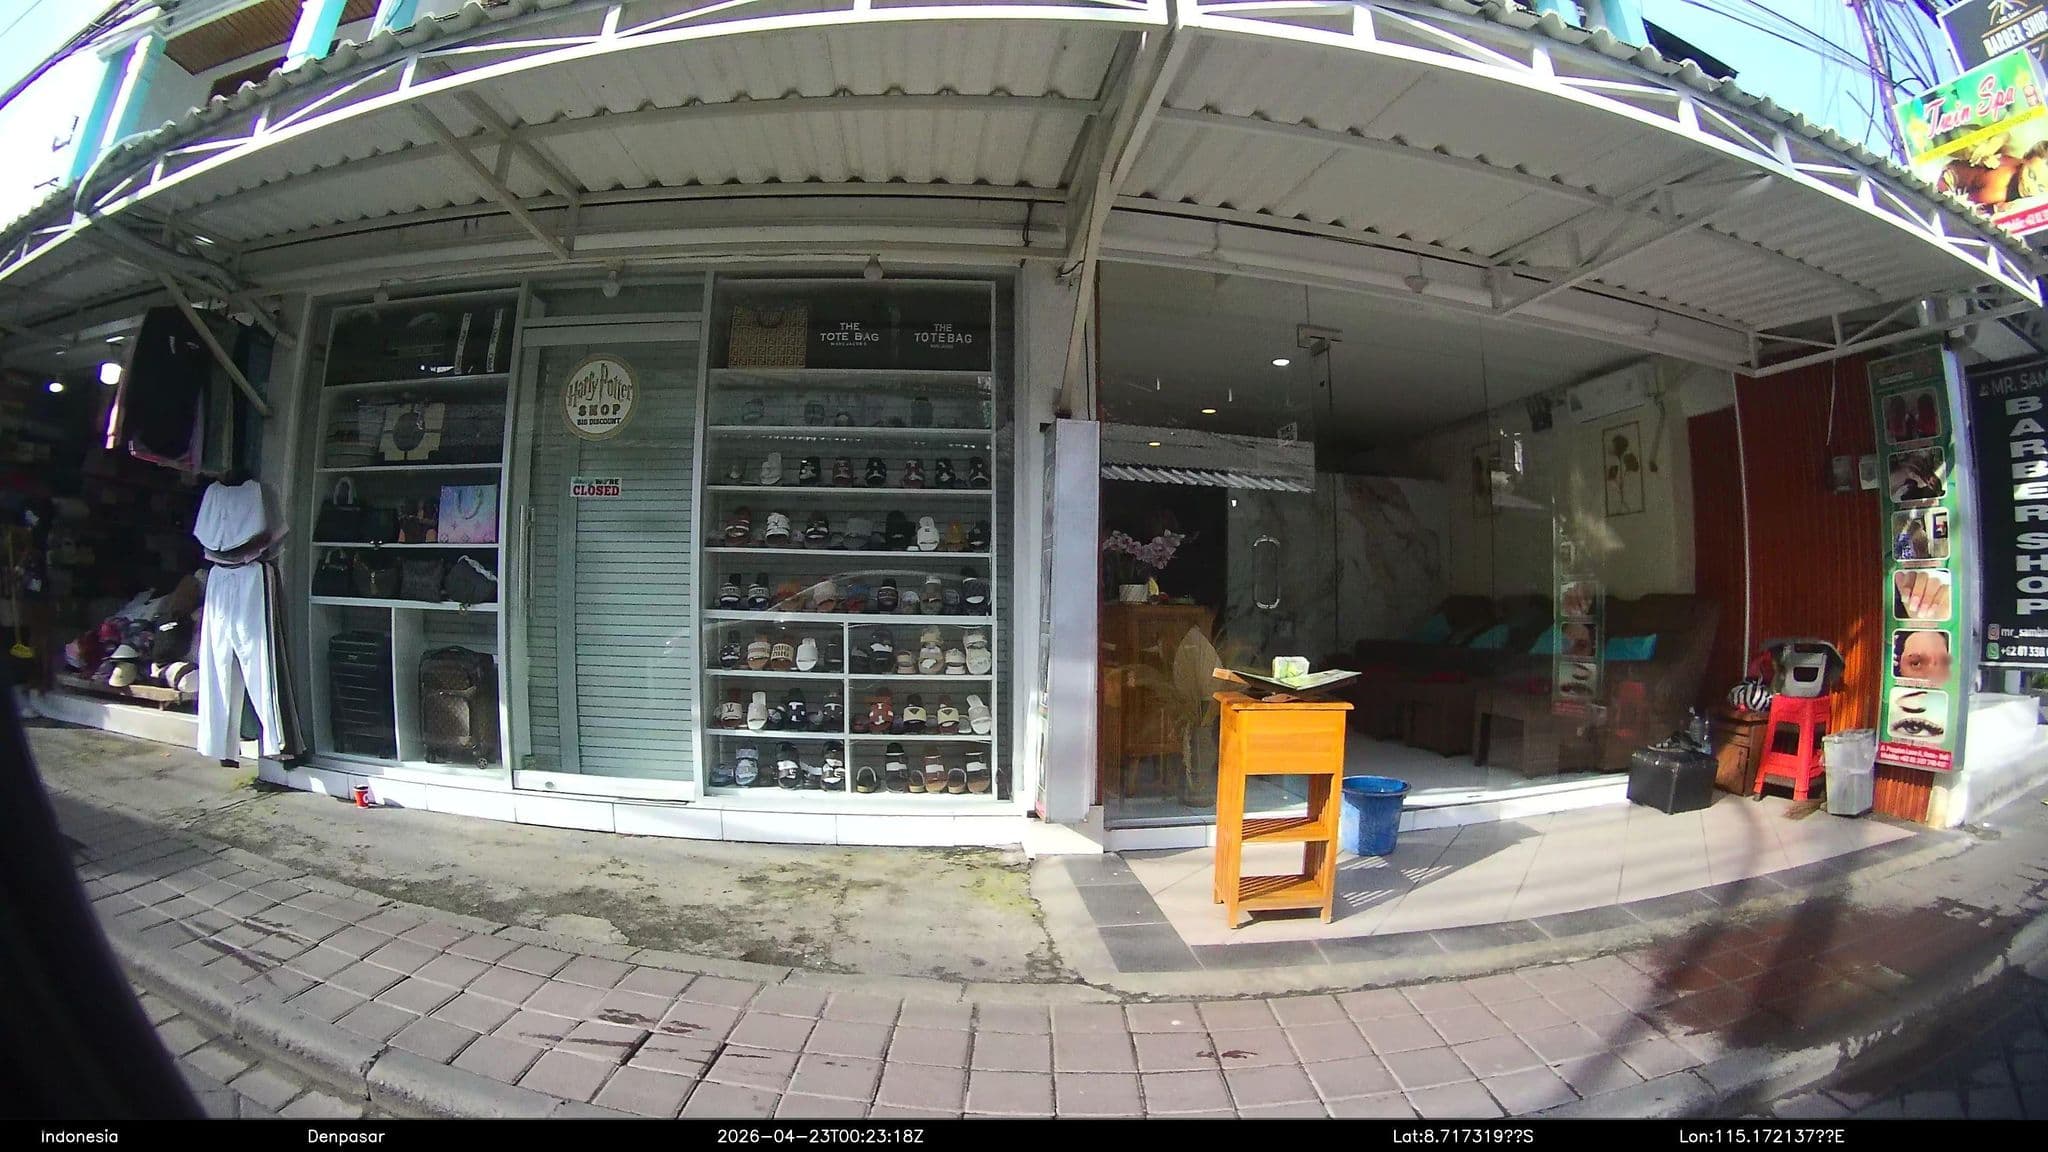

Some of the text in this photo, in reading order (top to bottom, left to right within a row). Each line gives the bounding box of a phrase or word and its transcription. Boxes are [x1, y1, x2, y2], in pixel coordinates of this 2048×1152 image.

[1925, 98, 1970, 139] Twin
[1977, 75, 2016, 121] Spa
[840, 322, 860, 330] THE
[934, 323, 952, 332] THE
[820, 332, 879, 341] TOTE BAG
[914, 332, 973, 343] TOTE BAG
[567, 363, 633, 408] Harry Potter
[1991, 376, 2017, 397] MR.
[578, 403, 621, 417] SHOP
[589, 417, 622, 425] DISCOUNT
[2005, 396, 2048, 522] BARBER
[573, 485, 620, 496] CLOSED
[2015, 531, 2048, 615] SHOP
